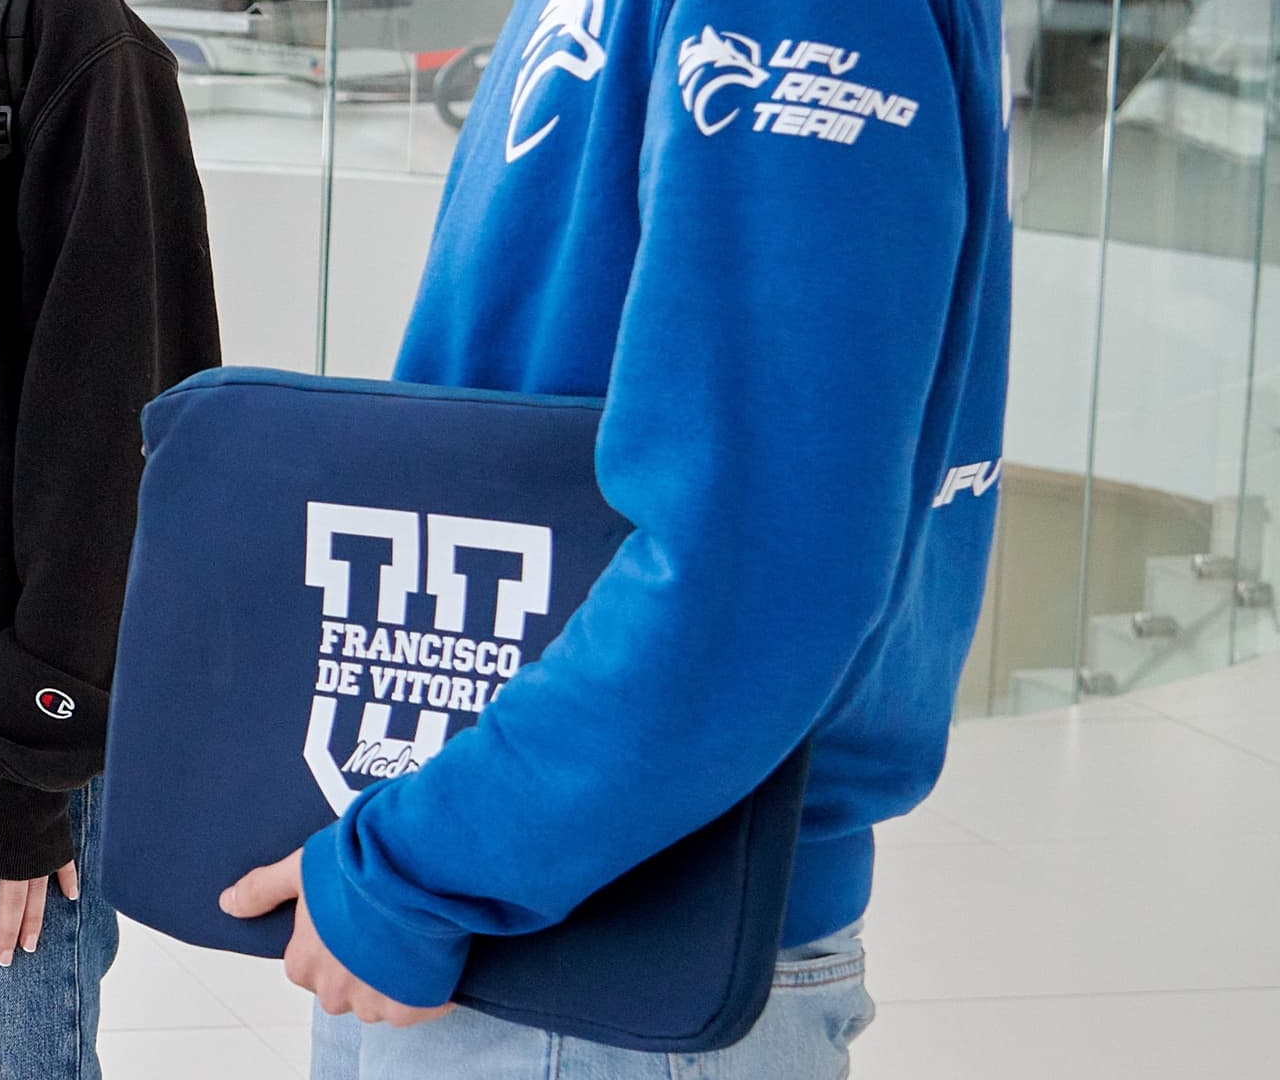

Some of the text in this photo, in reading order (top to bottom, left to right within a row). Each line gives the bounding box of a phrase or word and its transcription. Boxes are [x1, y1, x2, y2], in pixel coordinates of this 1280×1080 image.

[768, 39, 860, 75] UFV
[771, 72, 919, 128] RACING
[752, 102, 866, 145] TEAM
[319, 621, 520, 678] FRANCISCO
[313, 659, 363, 696] DE
[340, 739, 420, 779] Madr
